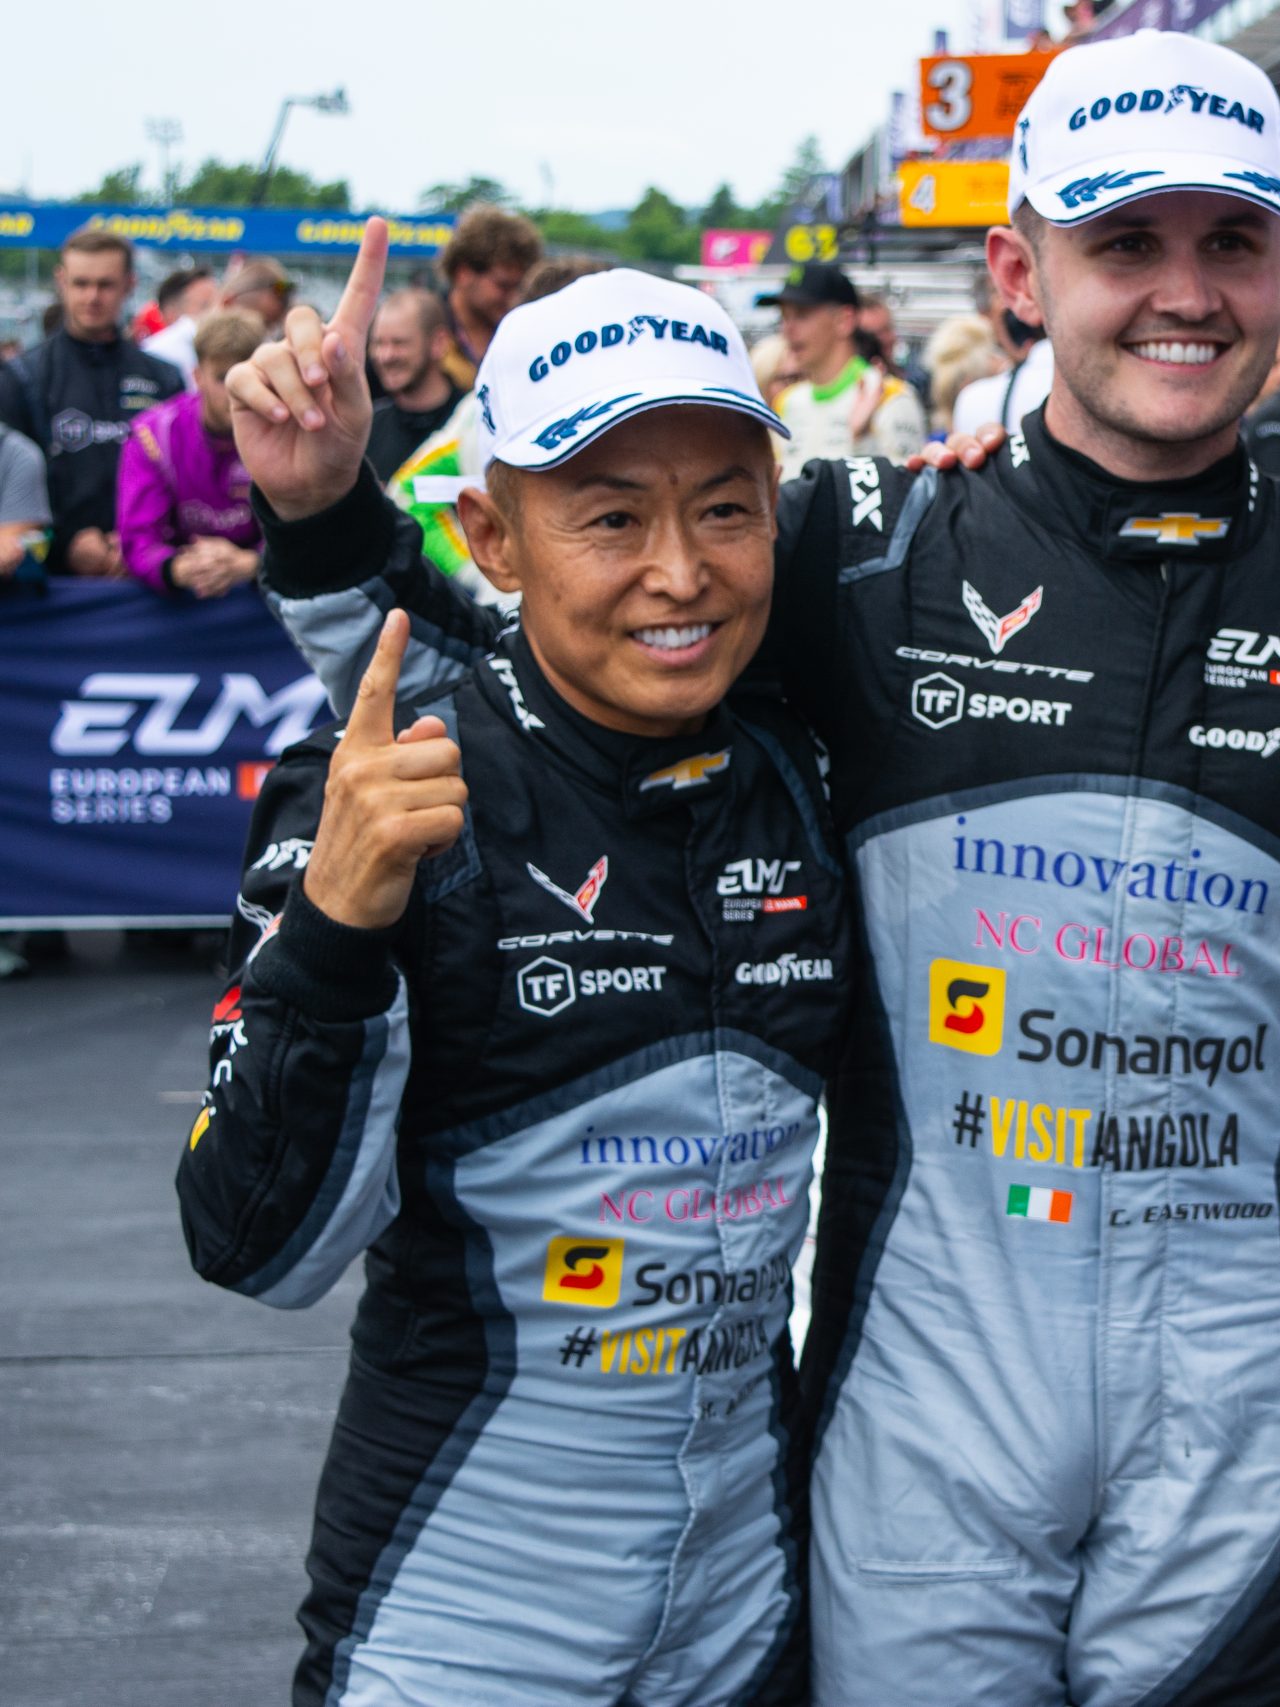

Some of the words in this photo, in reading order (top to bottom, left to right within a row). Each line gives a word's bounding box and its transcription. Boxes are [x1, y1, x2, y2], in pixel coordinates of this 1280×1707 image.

[926, 60, 972, 131] 3
[1068, 85, 1266, 135] GOODYEAR
[909, 174, 937, 214] 4
[529, 315, 729, 382] GOODYEAR
[896, 646, 1094, 683] CORVETTE
[51, 672, 328, 756] ELM
[919, 690, 957, 714] TF
[968, 692, 1072, 726] SPORT
[51, 767, 231, 797] EUROPEAN
[52, 795, 172, 824] SERIES
[716, 858, 802, 895] ELMS
[953, 815, 1270, 916] innovation
[723, 910, 755, 921] SERIES
[497, 930, 674, 950] CORVETTE
[974, 908, 1042, 954] NC
[1055, 922, 1243, 977] GLOBAL
[526, 974, 564, 998] TF
[580, 966, 666, 994] SPORT
[1018, 1009, 1268, 1088] Sonangol
[953, 1091, 1240, 1172] #VISITANGOLA
[598, 1190, 653, 1224] NC
[1109, 1208, 1132, 1227] C.
[1143, 1202, 1273, 1223] EASTWOOD
